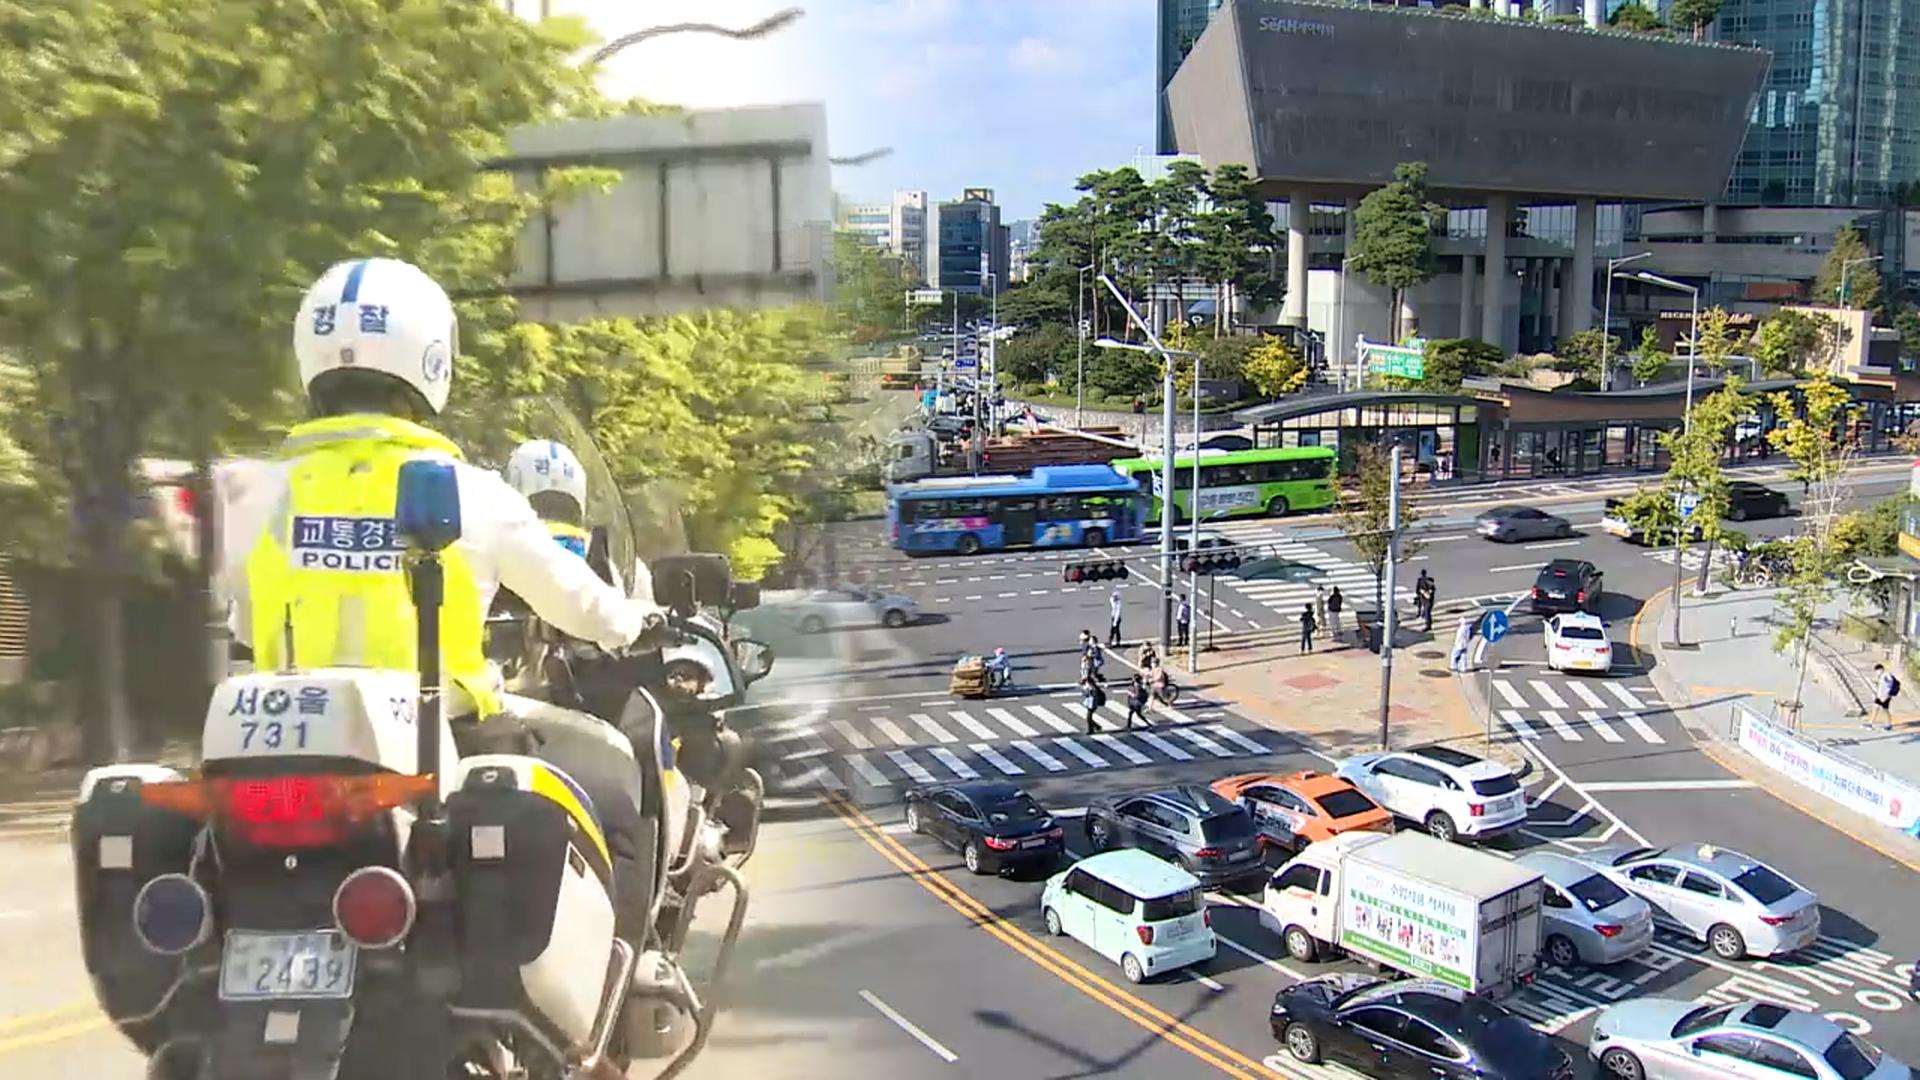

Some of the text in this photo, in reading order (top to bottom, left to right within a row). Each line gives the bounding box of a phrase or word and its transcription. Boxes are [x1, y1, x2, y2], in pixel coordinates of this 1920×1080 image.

[302, 552, 399, 569] POLIC
[240, 722, 309, 749] 731
[256, 956, 343, 990] 2439
